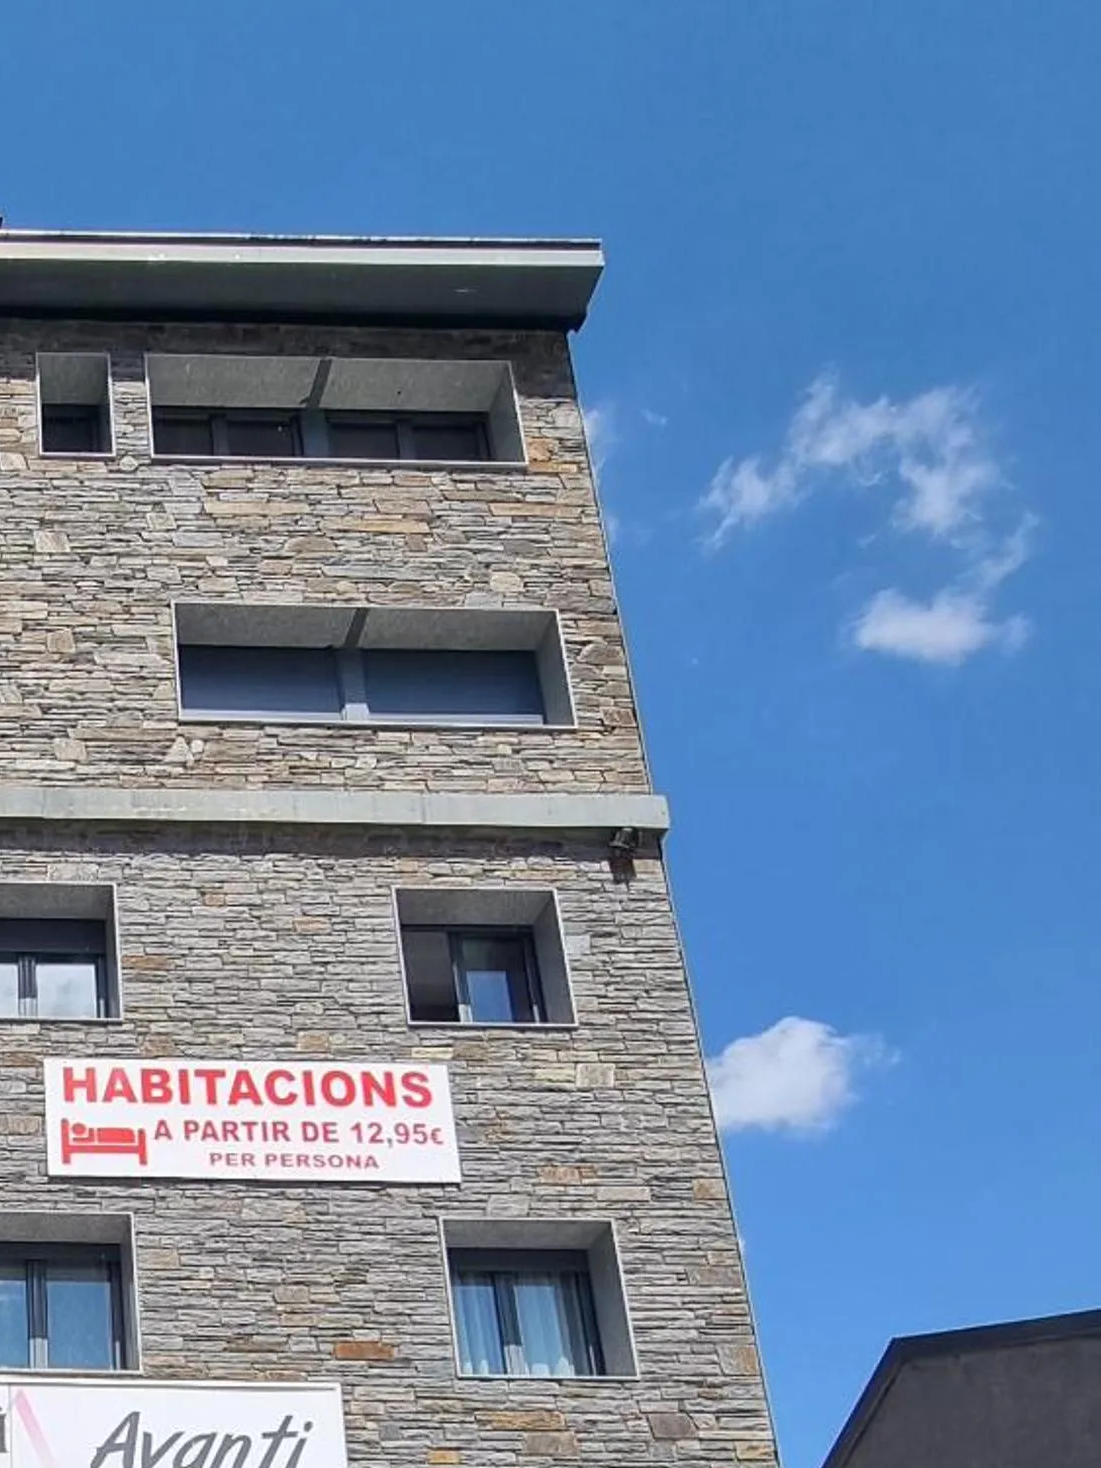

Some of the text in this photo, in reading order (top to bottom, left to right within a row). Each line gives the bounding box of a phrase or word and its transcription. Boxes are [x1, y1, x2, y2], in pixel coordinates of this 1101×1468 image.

[62, 1066, 433, 1109] HABITACIONS
[154, 1119, 444, 1148] A PARTIR DE 12,95€
[210, 1152, 380, 1170] PER PERSONA
